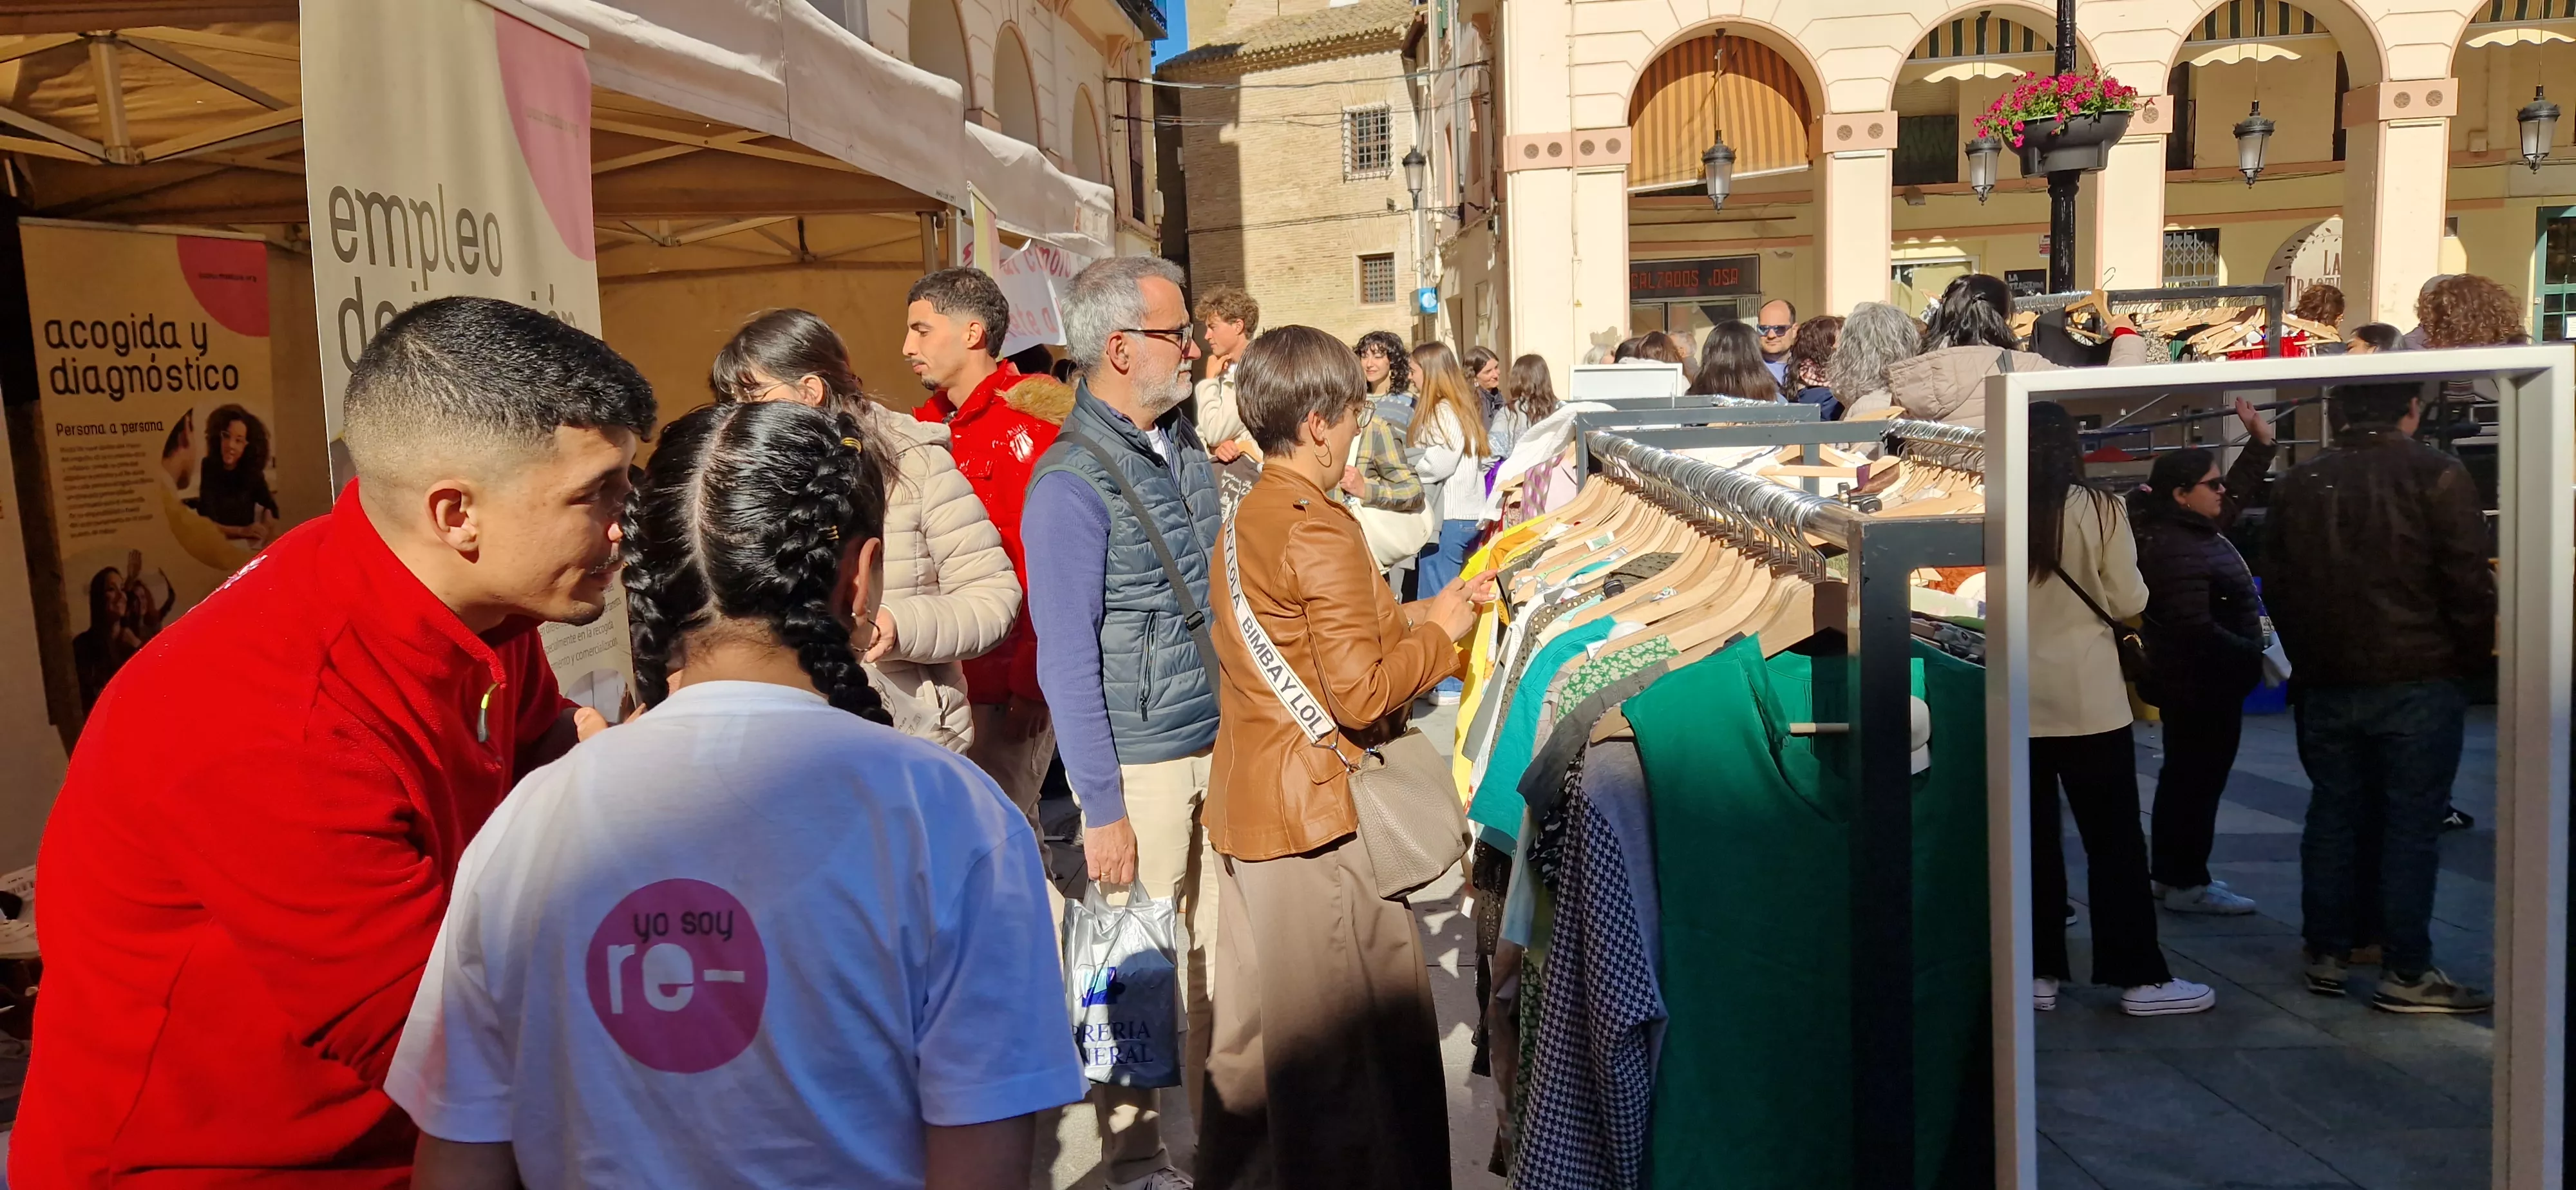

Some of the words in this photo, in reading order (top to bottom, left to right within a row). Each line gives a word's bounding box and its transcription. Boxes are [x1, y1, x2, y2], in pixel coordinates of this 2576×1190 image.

[328, 183, 504, 291] empleo
[2323, 250, 2341, 276] LA
[1631, 270, 1699, 290] CALZADOS
[2008, 273, 2018, 282] LA
[44, 312, 181, 356] acogida
[191, 318, 208, 356] y
[50, 353, 240, 402] diagnóstico
[56, 421, 106, 437] Persona
[109, 422, 118, 434] a
[121, 420, 164, 436] persona
[1227, 557, 1242, 612] LOLA
[577, 631, 586, 641] en
[586, 627, 592, 638] la
[633, 912, 669, 945] yo
[681, 909, 734, 941] soy
[607, 942, 745, 1015] re-
[1072, 1020, 1151, 1044] BRERIA
[1082, 1043, 1153, 1066] NERAL
